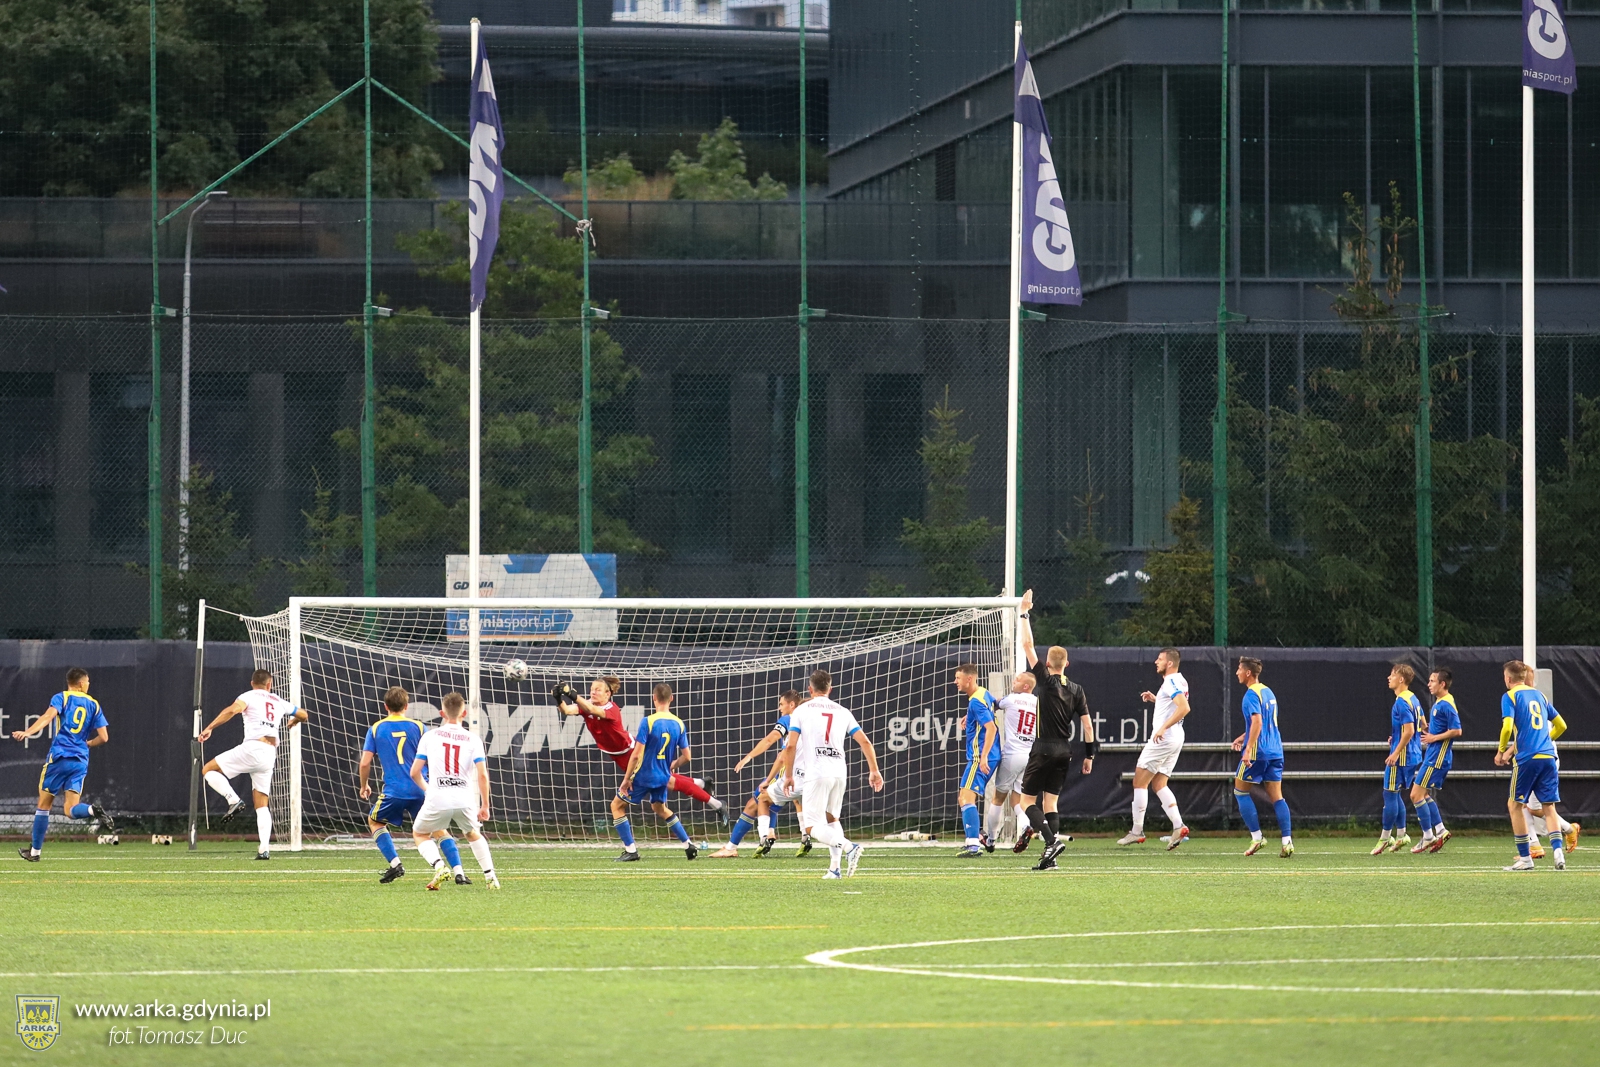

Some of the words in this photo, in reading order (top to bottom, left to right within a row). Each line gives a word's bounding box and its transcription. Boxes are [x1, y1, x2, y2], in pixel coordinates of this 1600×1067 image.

[70, 706, 87, 734] 9
[265, 701, 275, 722] 6
[1017, 709, 1036, 735] 19
[1529, 700, 1544, 730] 8
[821, 712, 834, 745] 7
[391, 731, 407, 765] 7
[442, 742, 461, 777] 11
[656, 732, 671, 760] 2
